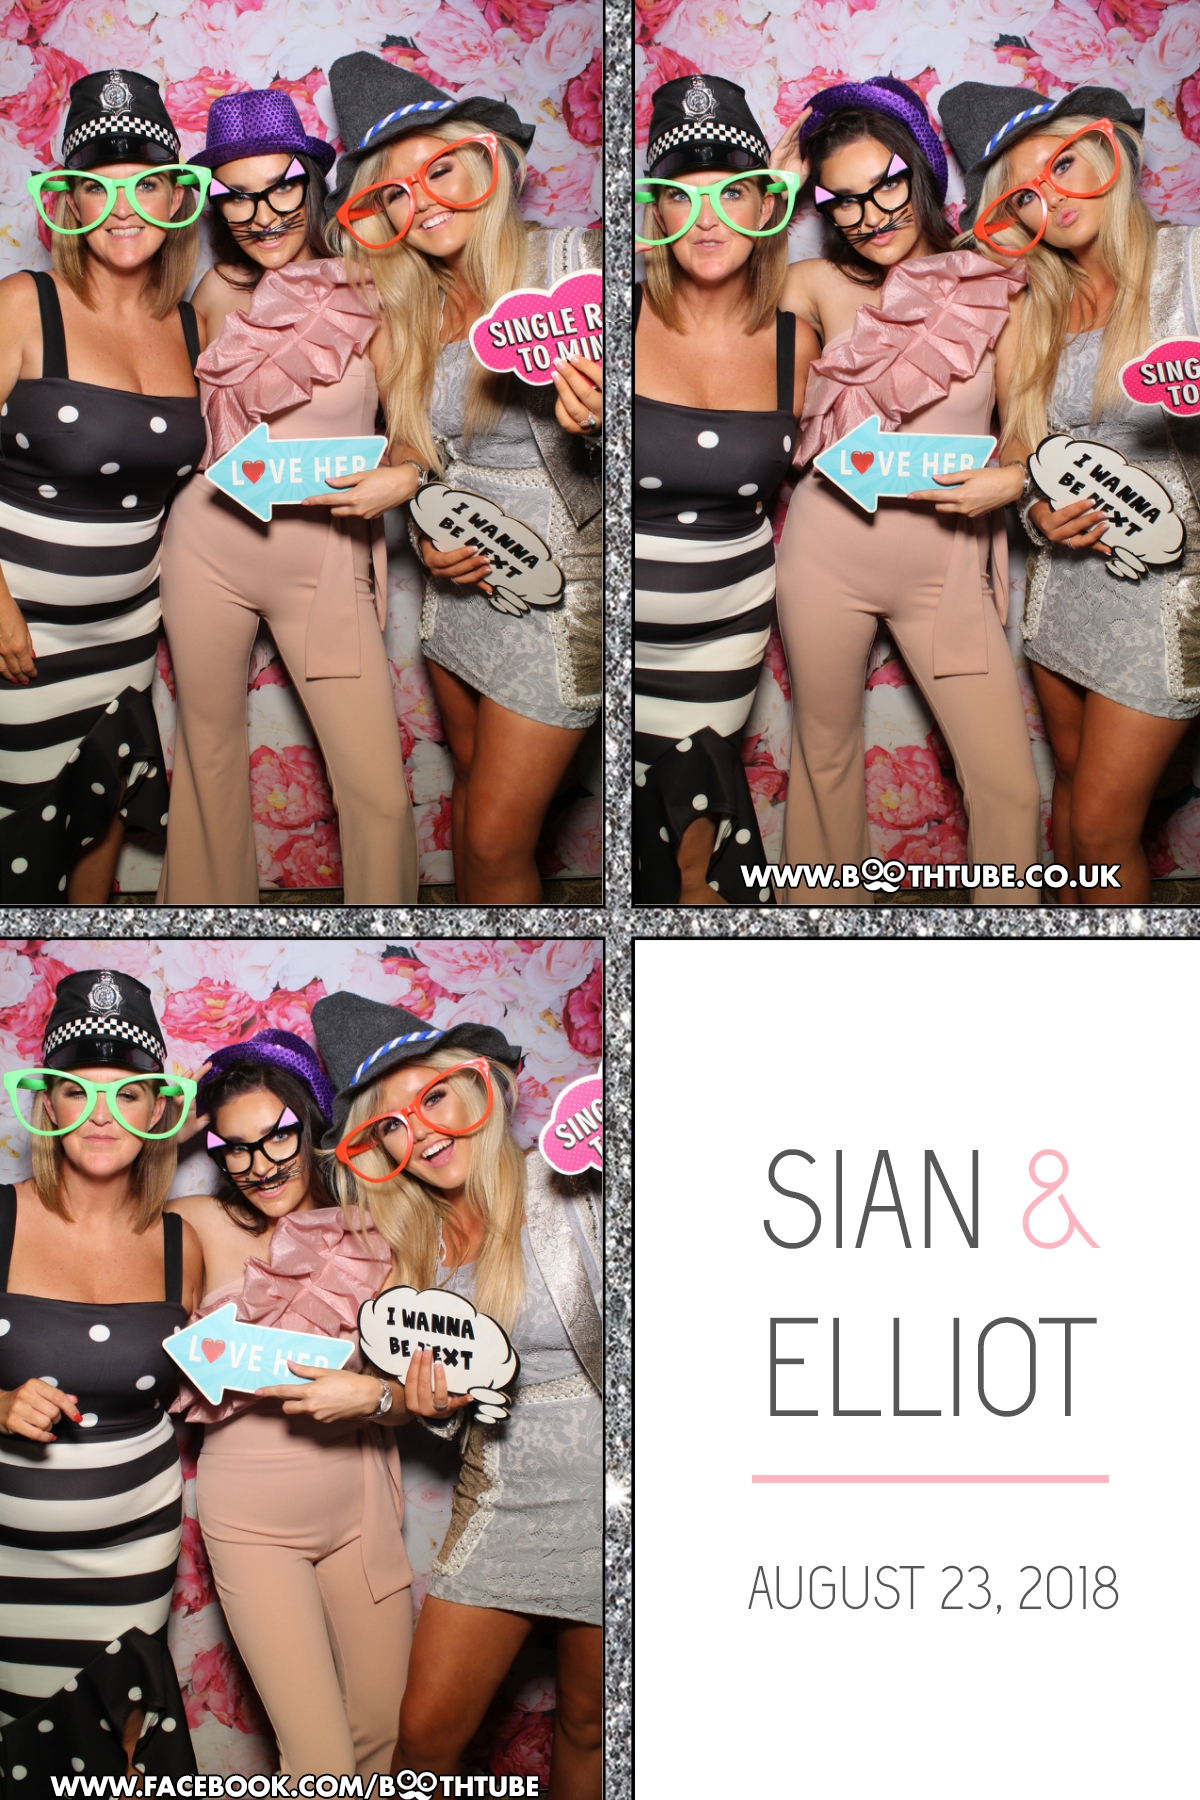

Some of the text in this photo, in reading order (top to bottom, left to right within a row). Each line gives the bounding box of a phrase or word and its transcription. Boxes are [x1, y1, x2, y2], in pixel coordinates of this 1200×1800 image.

[488, 306, 578, 348] SINGLE
[516, 344, 551, 373] TO
[1166, 383, 1200, 407] TO
[1058, 472, 1086, 496] BE
[1073, 453, 1161, 524] I WANNA
[438, 517, 465, 538] BE
[451, 502, 539, 569] I WANNA
[387, 1307, 475, 1340] I WANNA
[389, 1337, 473, 1370] BE EXT
